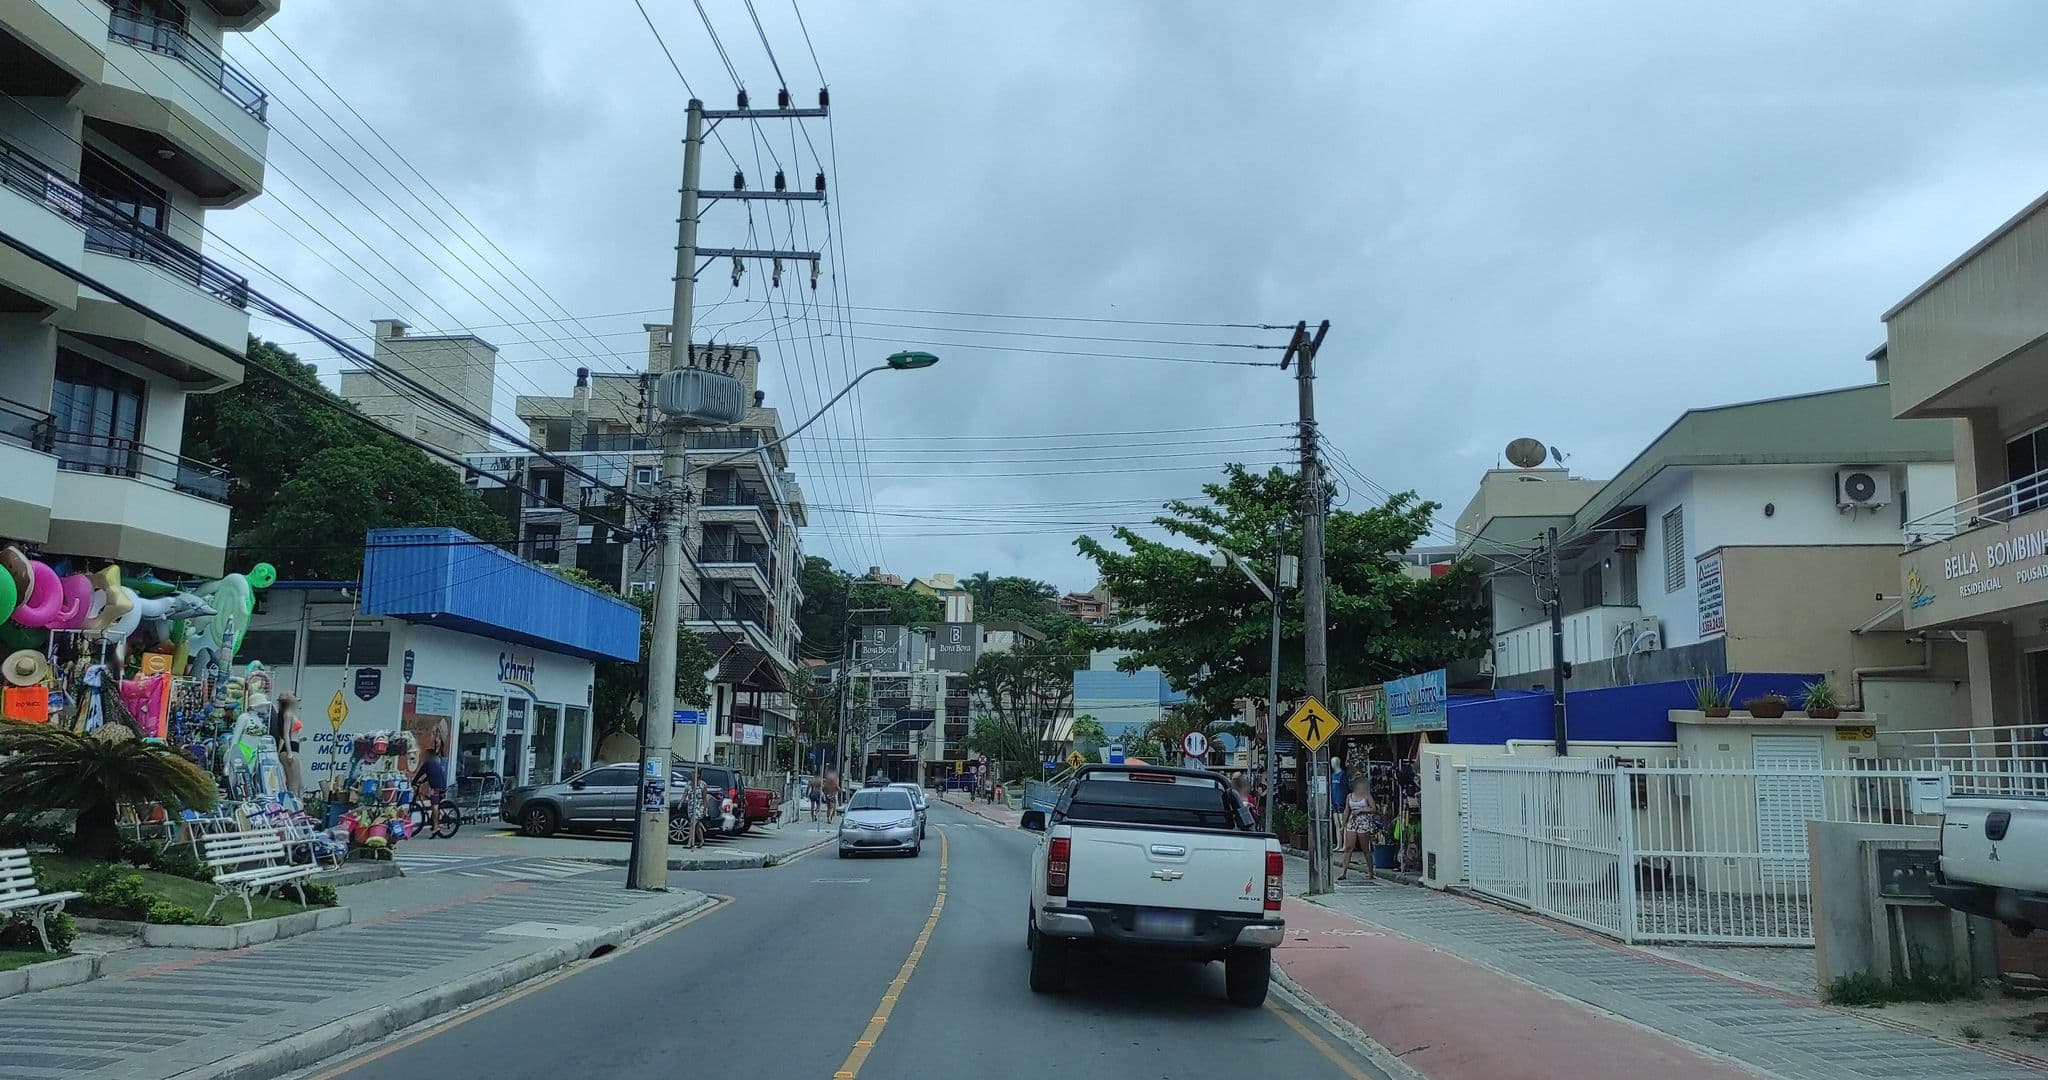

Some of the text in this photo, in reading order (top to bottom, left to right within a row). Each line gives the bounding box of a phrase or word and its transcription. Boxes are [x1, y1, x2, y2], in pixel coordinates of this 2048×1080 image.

[1944, 551, 1980, 580] BELLA
[1959, 564, 2048, 598] RESIDENCIAL POUSAD
[940, 644, 971, 652] Bora Bora
[498, 652, 535, 685] Schmit
[1346, 699, 1375, 722] MERMAID
